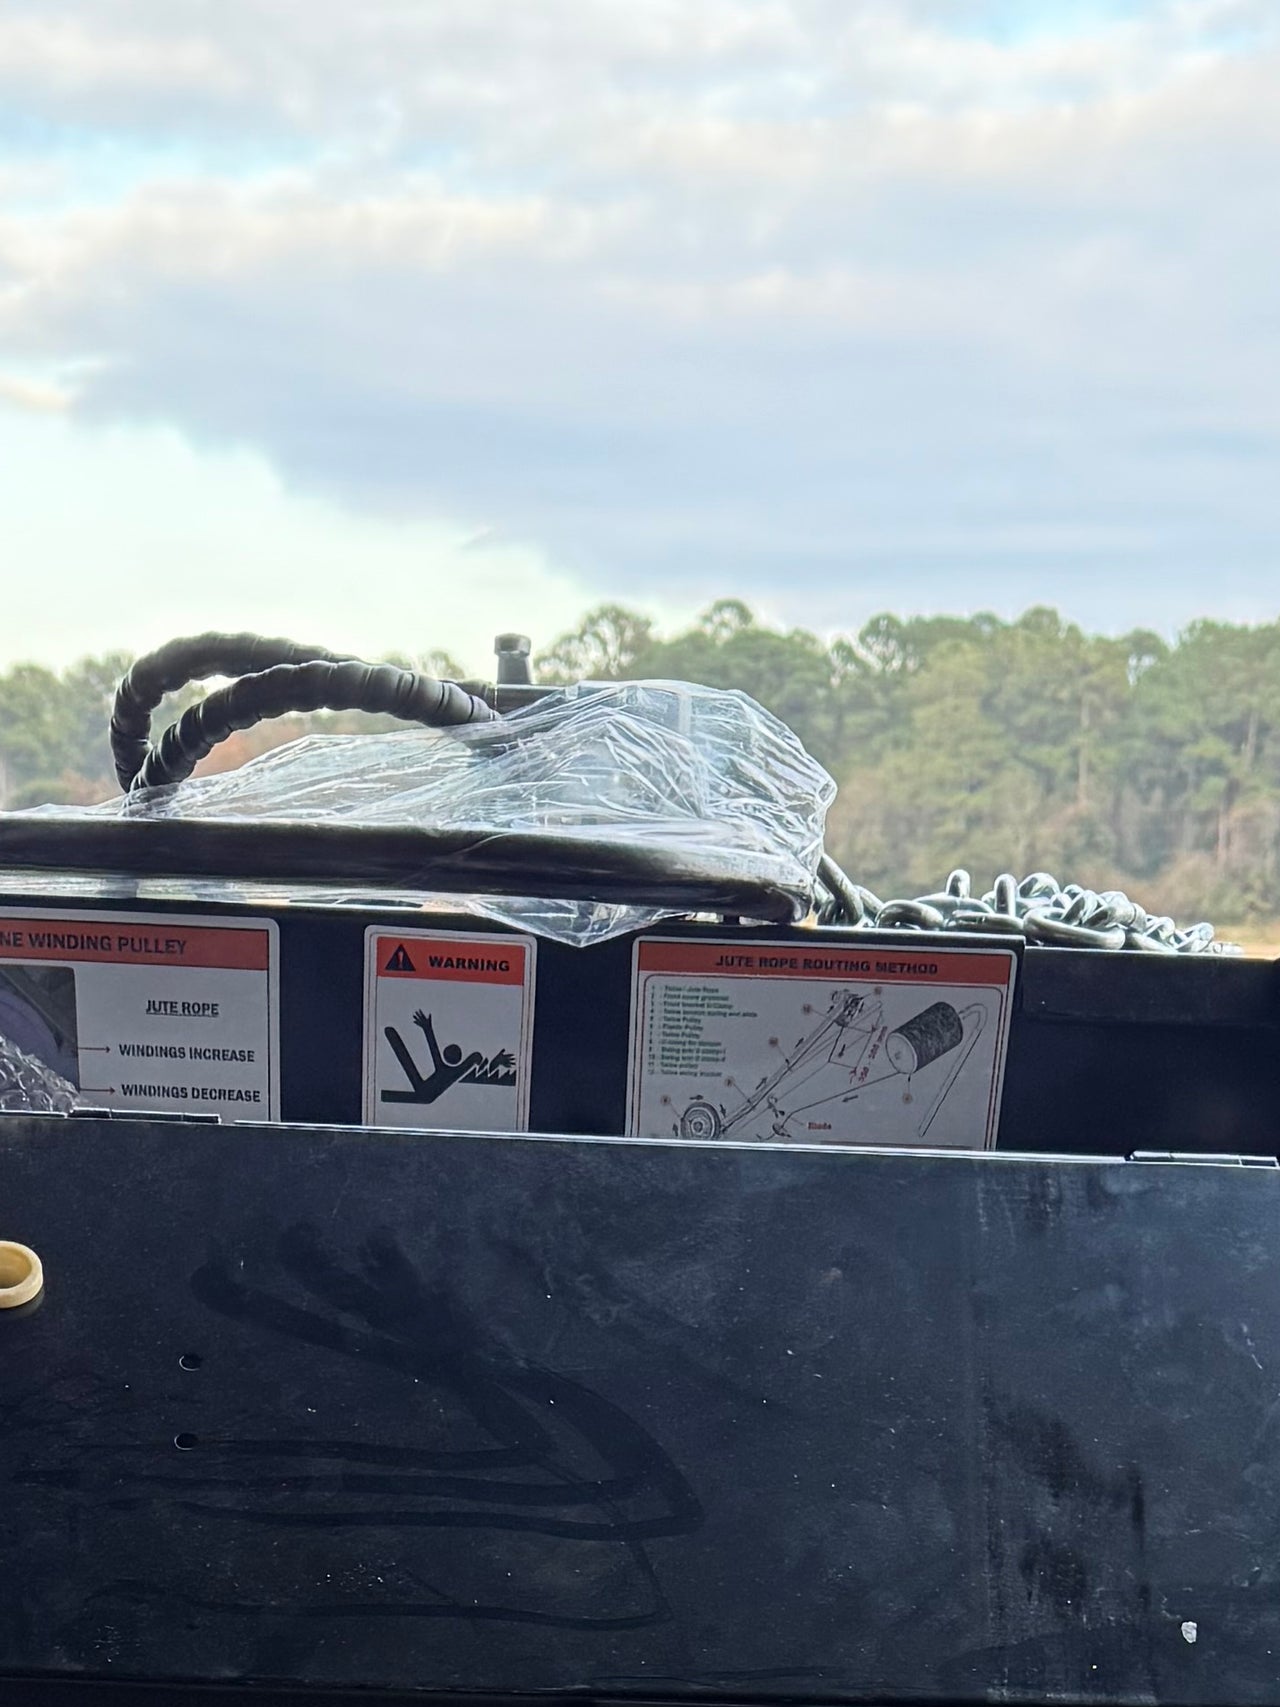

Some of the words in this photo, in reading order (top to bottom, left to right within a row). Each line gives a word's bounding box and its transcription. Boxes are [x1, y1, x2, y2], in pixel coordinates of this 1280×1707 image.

[28, 931, 113, 952] WINDING
[118, 934, 187, 956] PULLEY
[428, 955, 510, 972] WARNING
[715, 955, 755, 968] JUTE
[758, 957, 798, 969] ROPE
[803, 958, 871, 972] ROUTING
[876, 961, 939, 975] METHOD
[145, 999, 178, 1016] JUTE
[181, 1000, 220, 1017] ROPE
[118, 1043, 187, 1061] WINDINGS
[189, 1046, 256, 1063] INCREASE
[121, 1083, 189, 1101] WINDINGS
[191, 1085, 261, 1103] DECREASE
